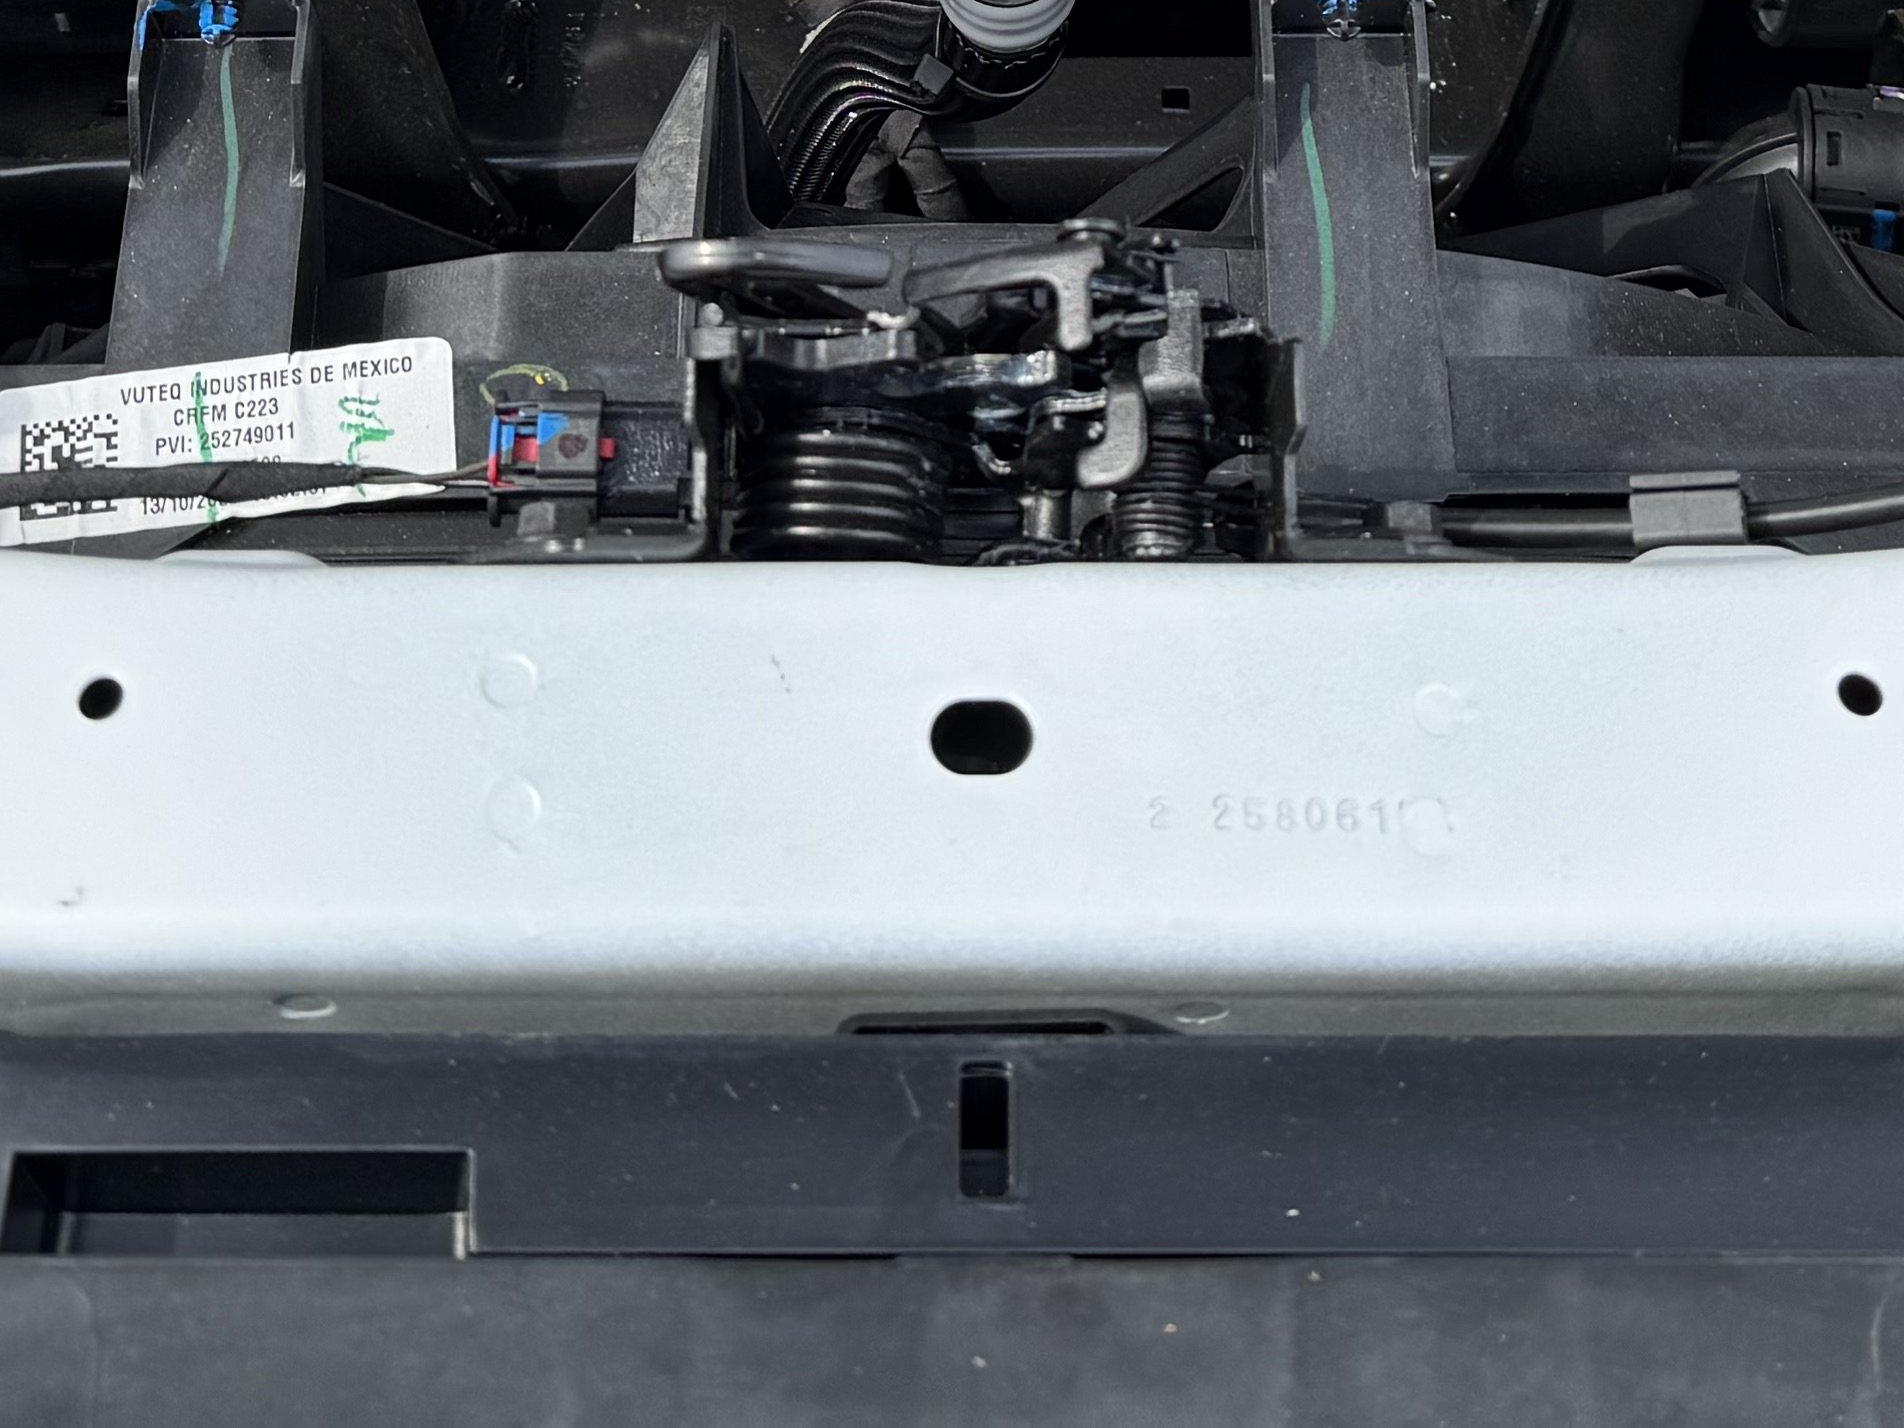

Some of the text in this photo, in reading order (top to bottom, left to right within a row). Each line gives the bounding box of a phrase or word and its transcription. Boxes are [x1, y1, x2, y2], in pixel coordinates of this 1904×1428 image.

[120, 356, 413, 407] VUTEQ INDUSTRIES DE MEXICO
[235, 397, 280, 420] C223
[155, 421, 296, 455] PVI: 252749011
